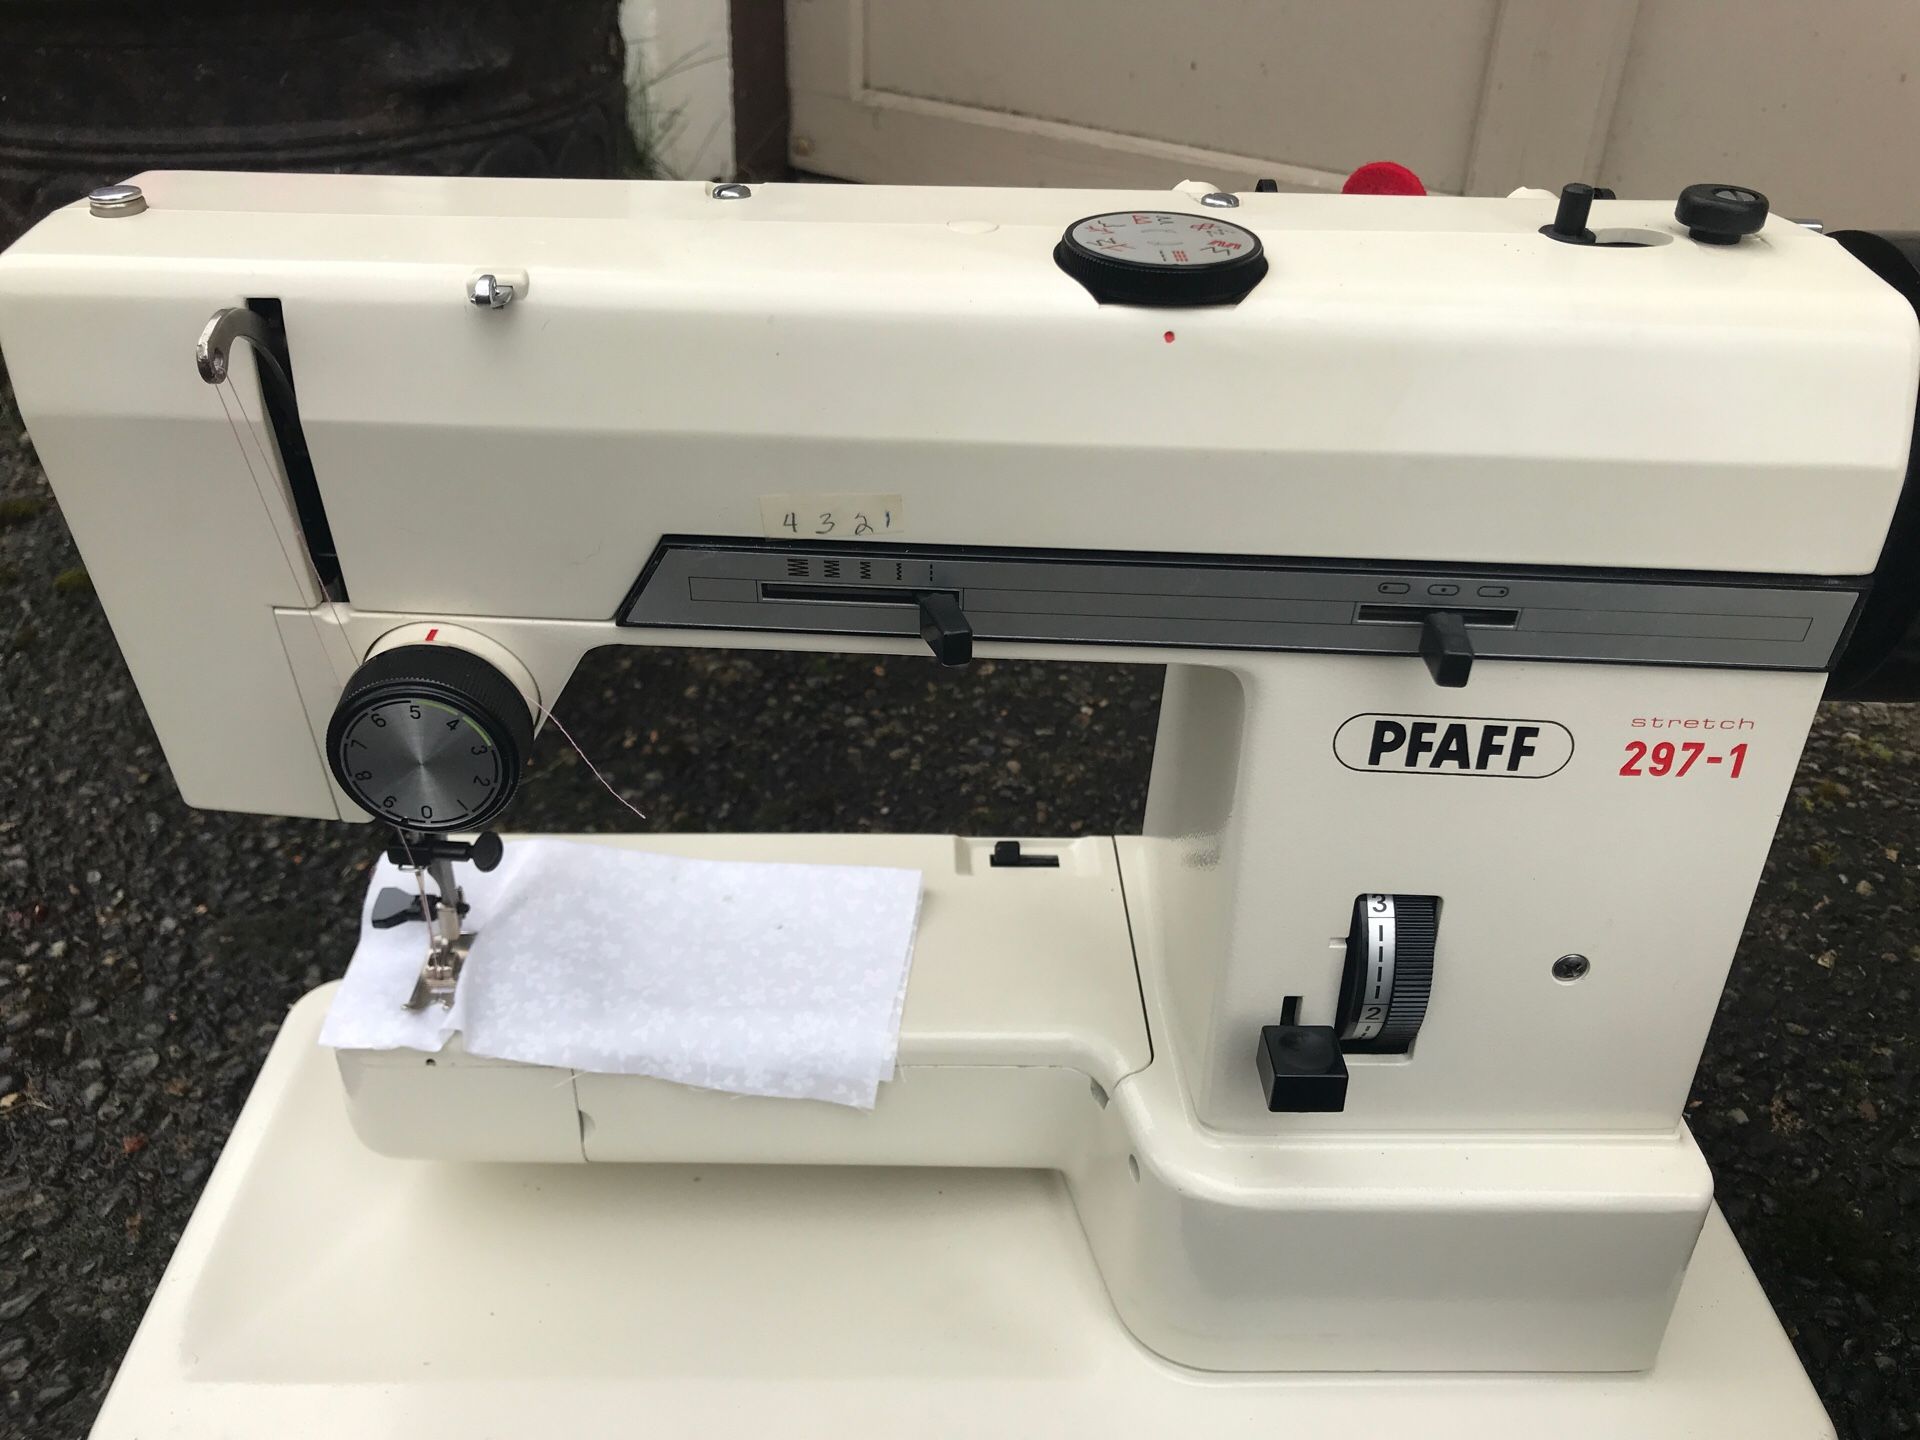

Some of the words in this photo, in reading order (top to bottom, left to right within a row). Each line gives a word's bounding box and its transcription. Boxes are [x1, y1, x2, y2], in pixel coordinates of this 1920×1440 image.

[783, 512, 798, 533] 4
[815, 513, 836, 535] 3
[854, 512, 875, 535] 2
[884, 511, 892, 529] 1
[409, 705, 422, 720] 5
[371, 713, 387, 728] 6
[446, 719, 461, 731] 4
[1630, 716, 1756, 732] stretch
[350, 739, 368, 750] 7
[471, 745, 488, 756] 3
[1368, 720, 1540, 772] PFAFF
[1619, 740, 1749, 779] 297-1
[355, 770, 372, 781] 8
[473, 775, 491, 787] 2
[421, 805, 433, 819] 0
[456, 799, 469, 811] 1
[1371, 894, 1388, 913] 3
[1365, 1006, 1382, 1020] 2
